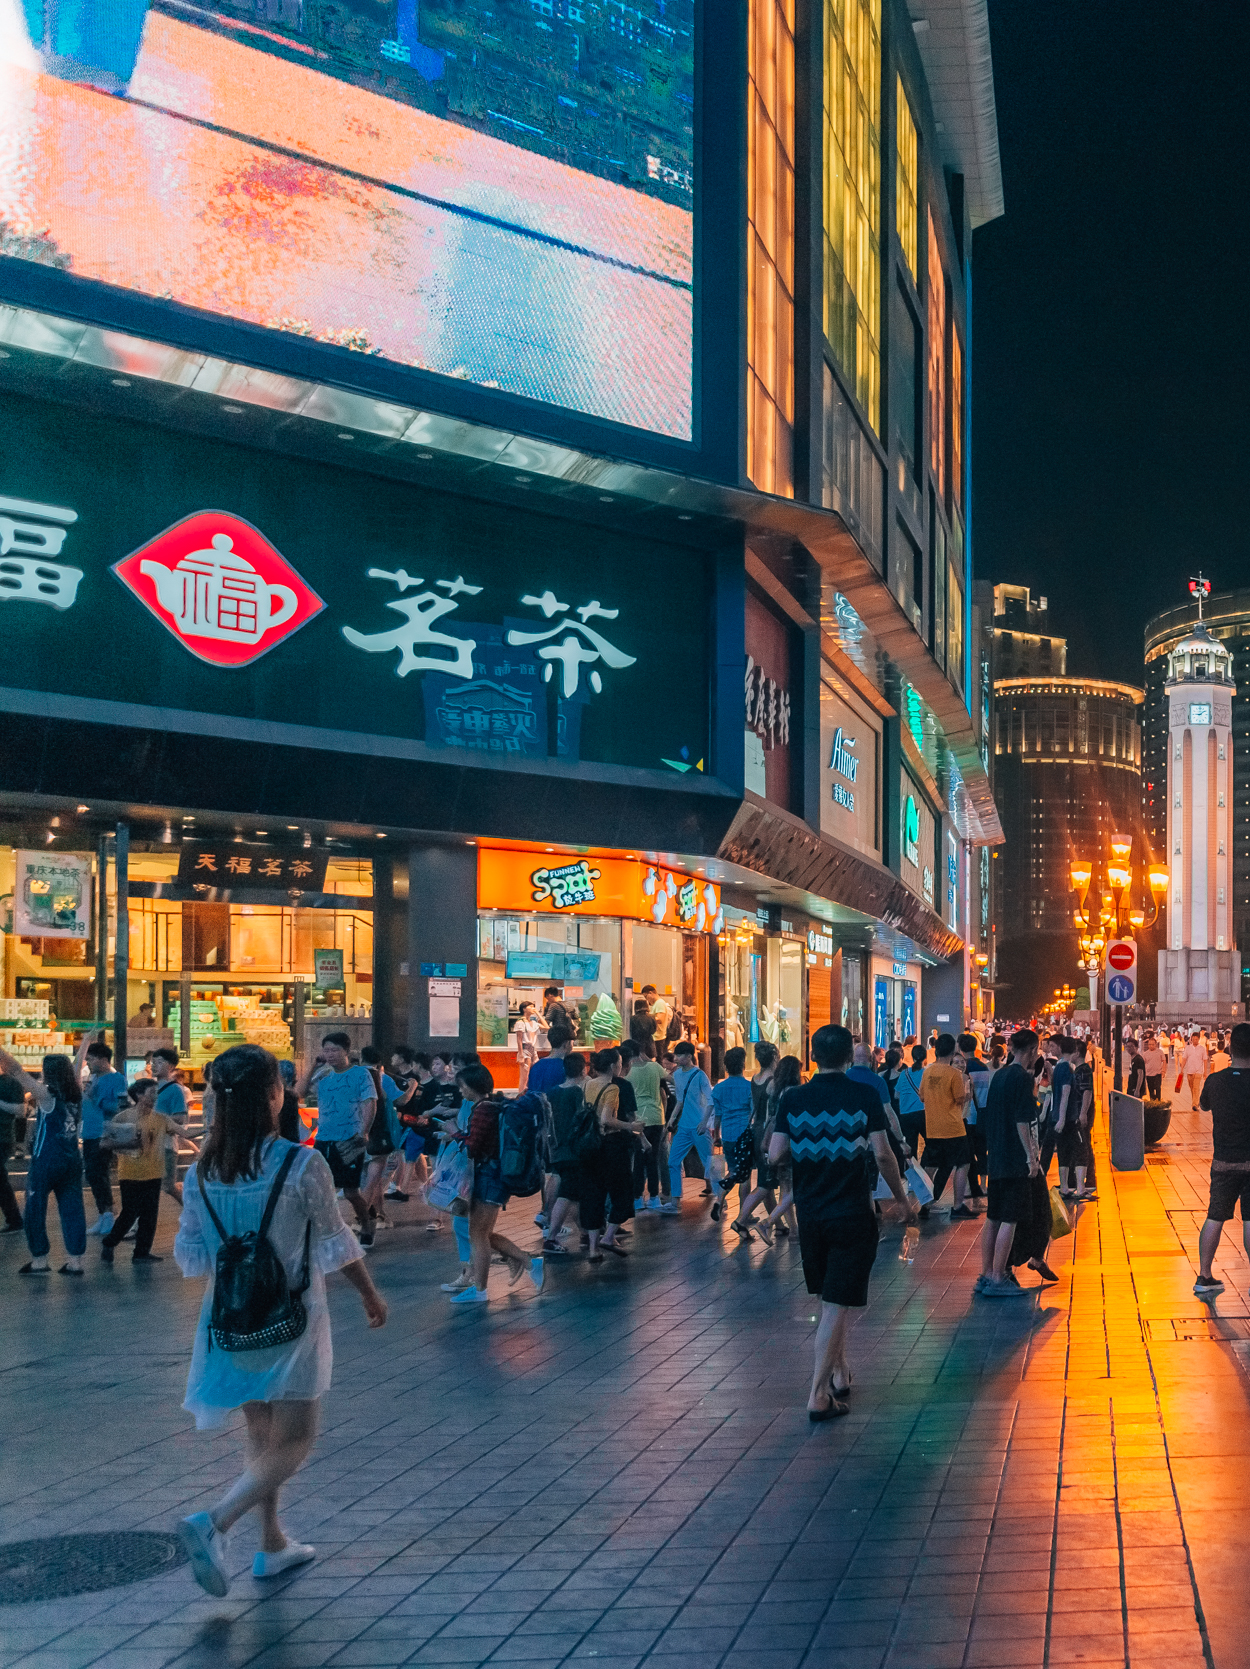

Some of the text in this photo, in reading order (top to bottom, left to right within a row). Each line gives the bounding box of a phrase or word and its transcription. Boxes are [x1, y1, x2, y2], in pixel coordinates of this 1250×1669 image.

[342, 567, 637, 698] 茗茶
[830, 726, 860, 783] Aimer
[26, 863, 80, 878] 重庆本地茶
[194, 853, 314, 879] 天福茗茶
